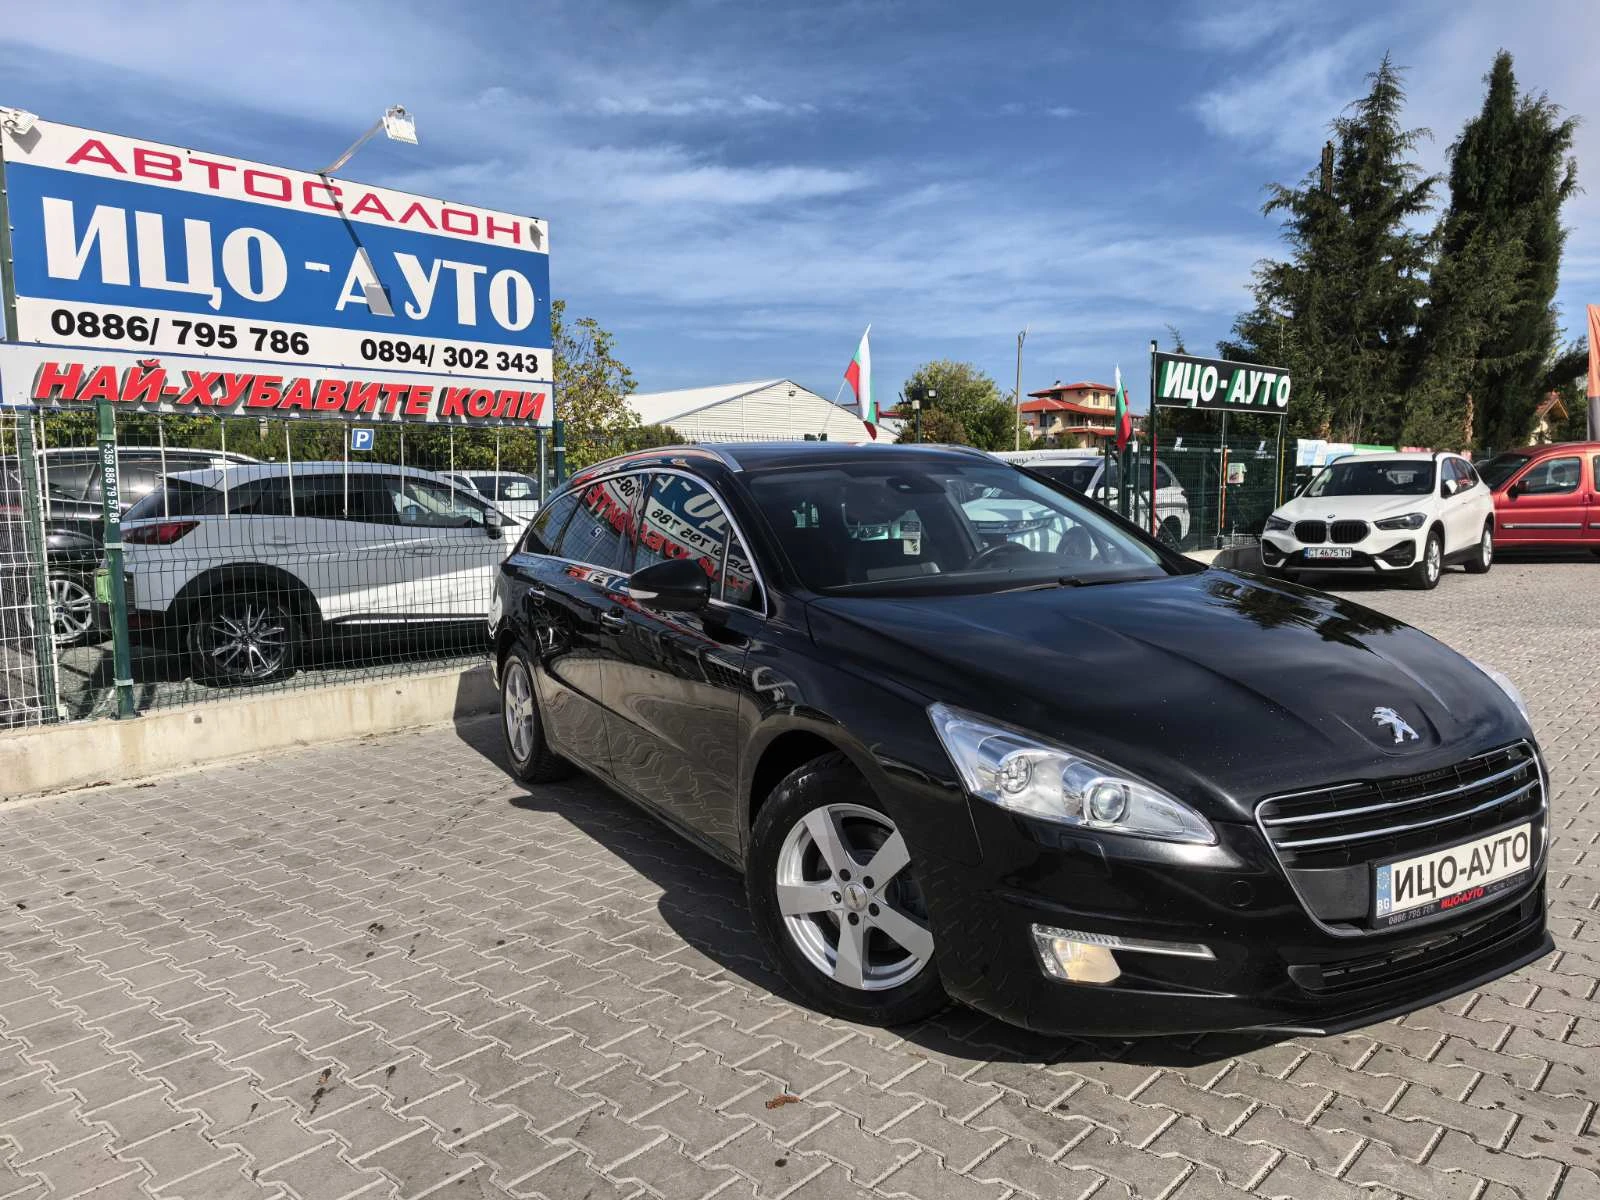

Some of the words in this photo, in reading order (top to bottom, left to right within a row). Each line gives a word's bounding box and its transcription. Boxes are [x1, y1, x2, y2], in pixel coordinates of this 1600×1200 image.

[66, 139, 521, 244] АВТОСАЛОН
[51, 309, 159, 345] 0886/
[172, 320, 238, 349] 795
[249, 327, 310, 356] 786
[360, 339, 435, 367] 0894/
[443, 347, 489, 370] 302
[496, 352, 539, 374] 343
[33, 358, 434, 416] НАЙ-ХУБАВИТЕ
[441, 387, 546, 422] КОЛИ
[1163, 360, 1291, 408] ИЦО-АУТО
[355, 431, 369, 448] P
[103, 442, 114, 466] +359
[104, 467, 116, 484] 886
[106, 486, 117, 497] 79
[107, 499, 119, 511] 57
[108, 512, 120, 524] 86
[1395, 831, 1529, 903] ИЦО-АУТО
[1376, 898, 1390, 913] BG
